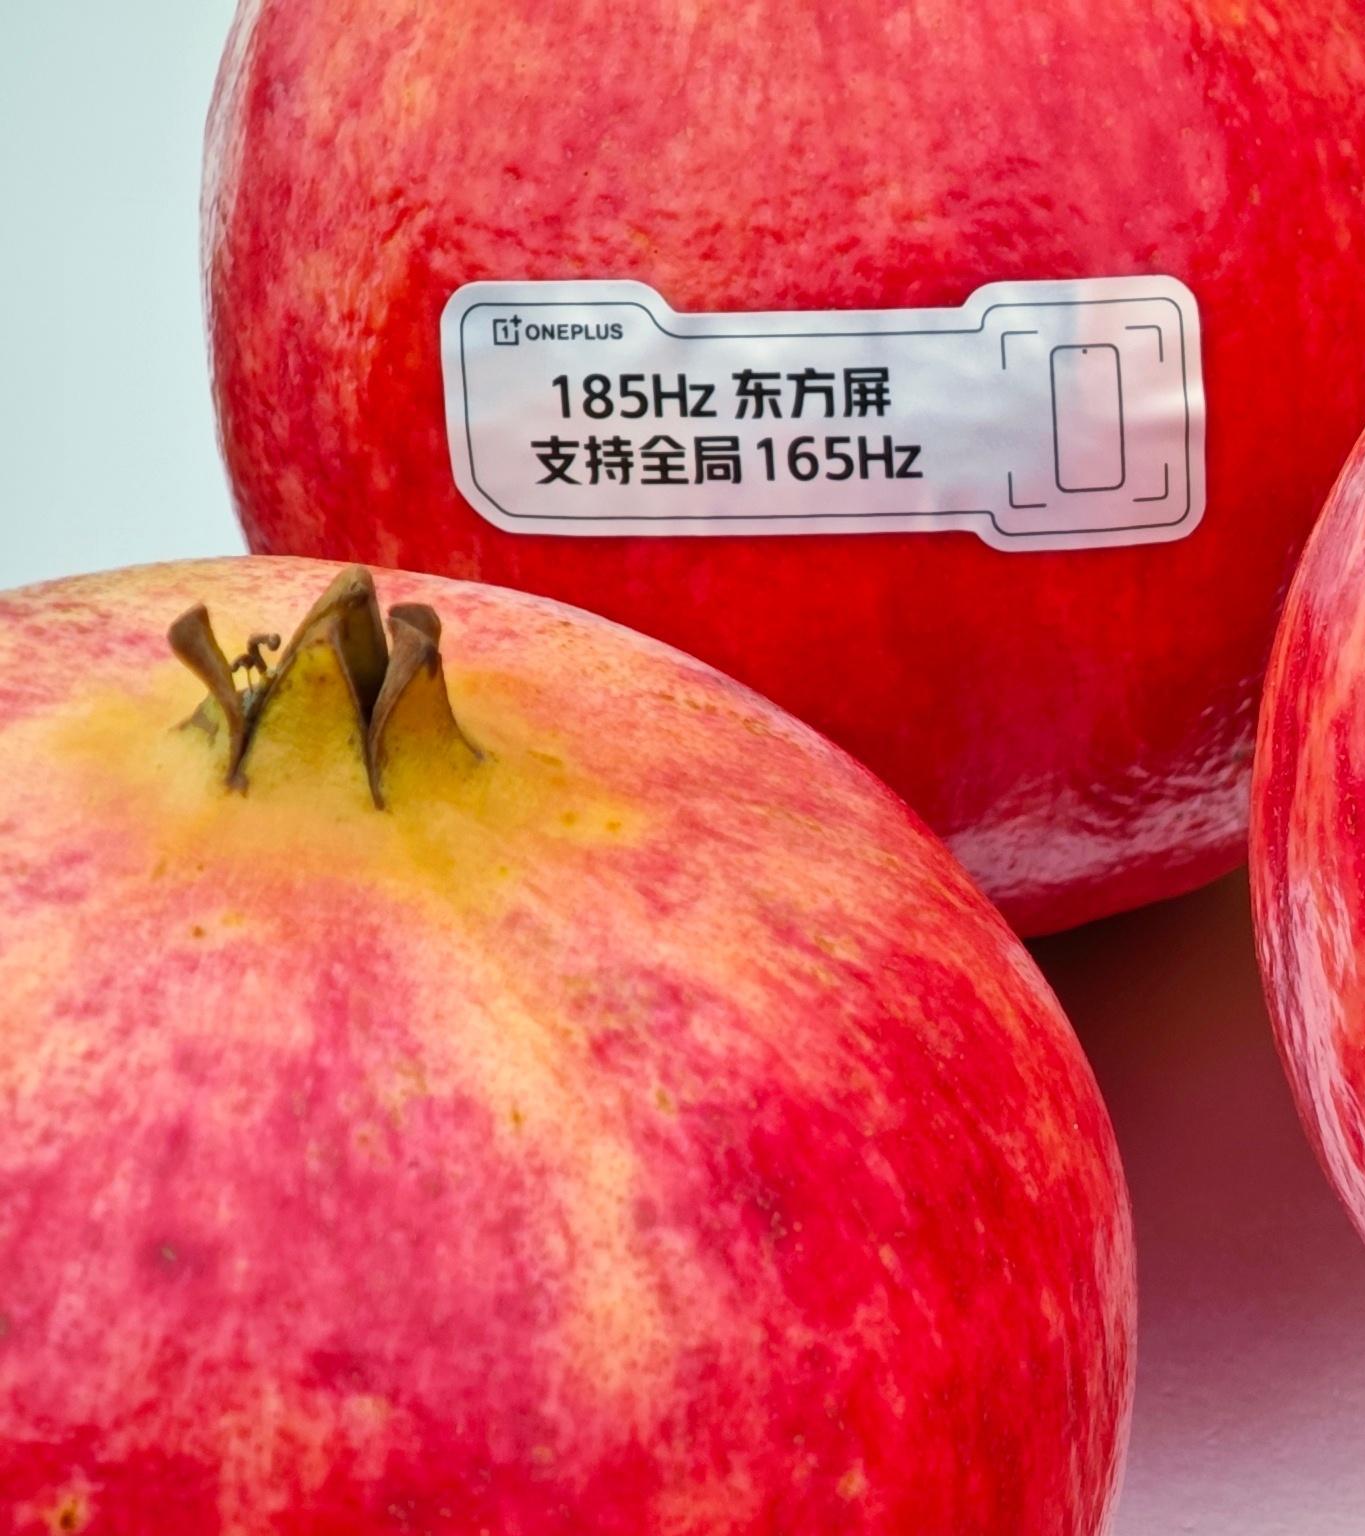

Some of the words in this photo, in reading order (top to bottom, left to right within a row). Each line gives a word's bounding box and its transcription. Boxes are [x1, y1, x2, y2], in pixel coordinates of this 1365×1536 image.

[525, 323, 623, 340] ONEPLUS
[552, 373, 717, 419] 185Hz
[732, 367, 891, 419] 东方屏
[531, 435, 742, 485] 支持全局
[756, 435, 923, 481] 165Hz
